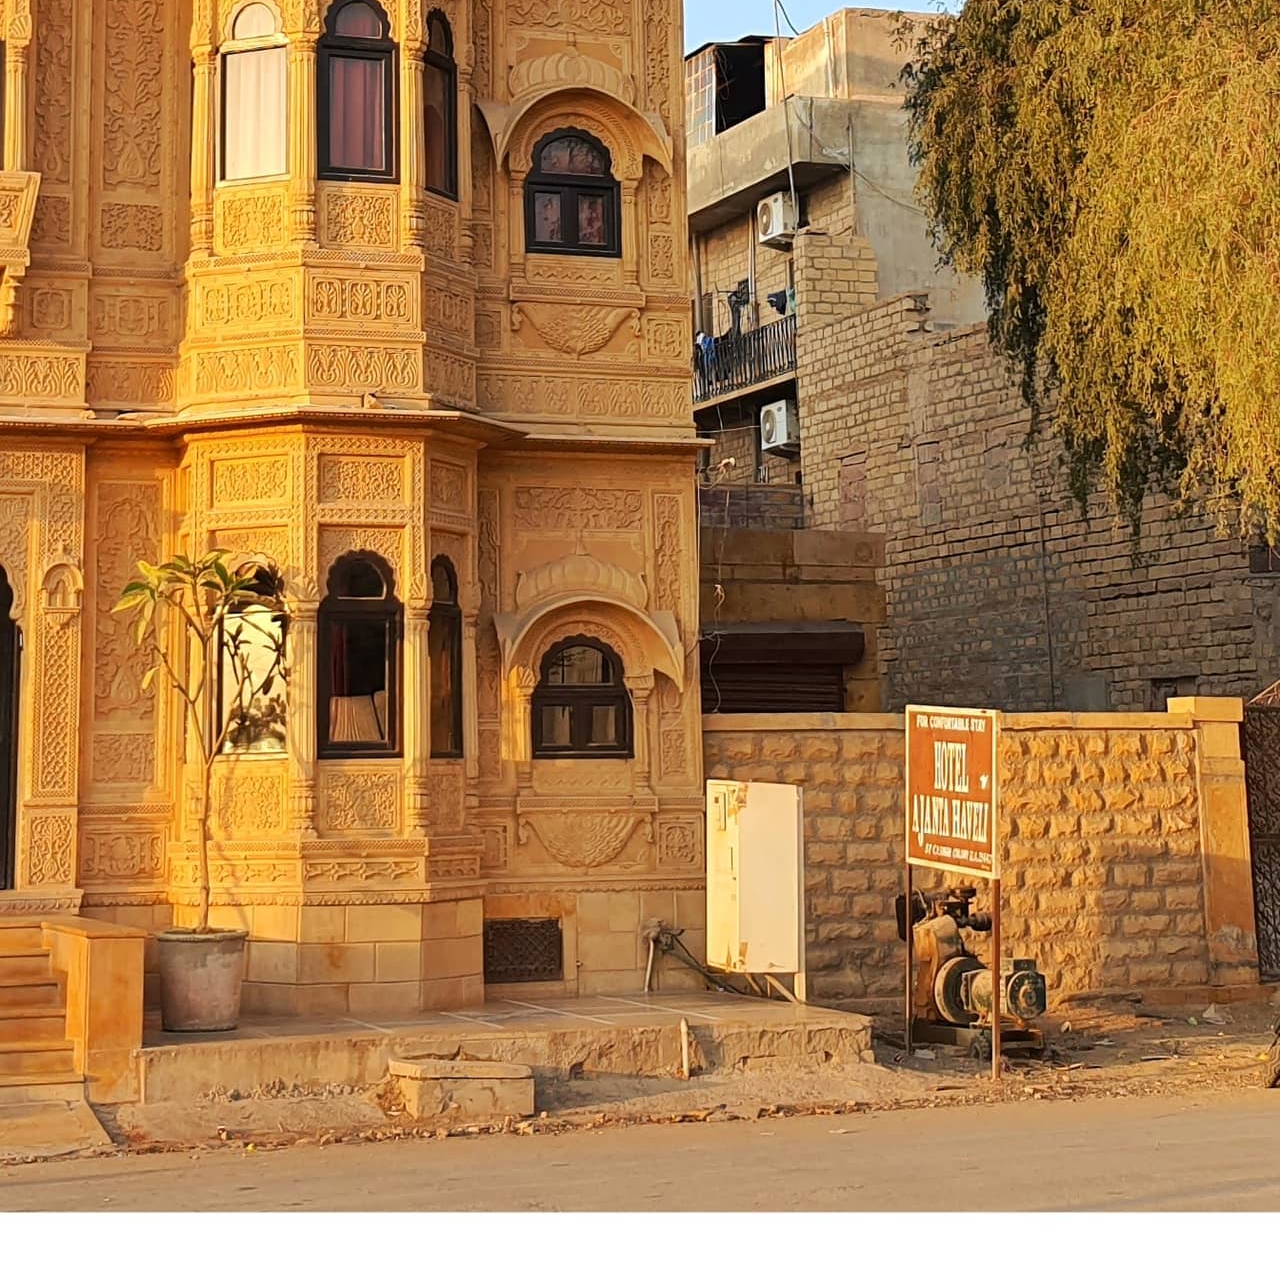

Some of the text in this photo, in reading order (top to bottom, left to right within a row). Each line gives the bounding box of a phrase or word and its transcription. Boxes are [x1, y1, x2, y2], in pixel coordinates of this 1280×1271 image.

[970, 719, 986, 733] STAY
[934, 741, 969, 793] HOTEL
[912, 794, 989, 847] AJANTA HAVELI
